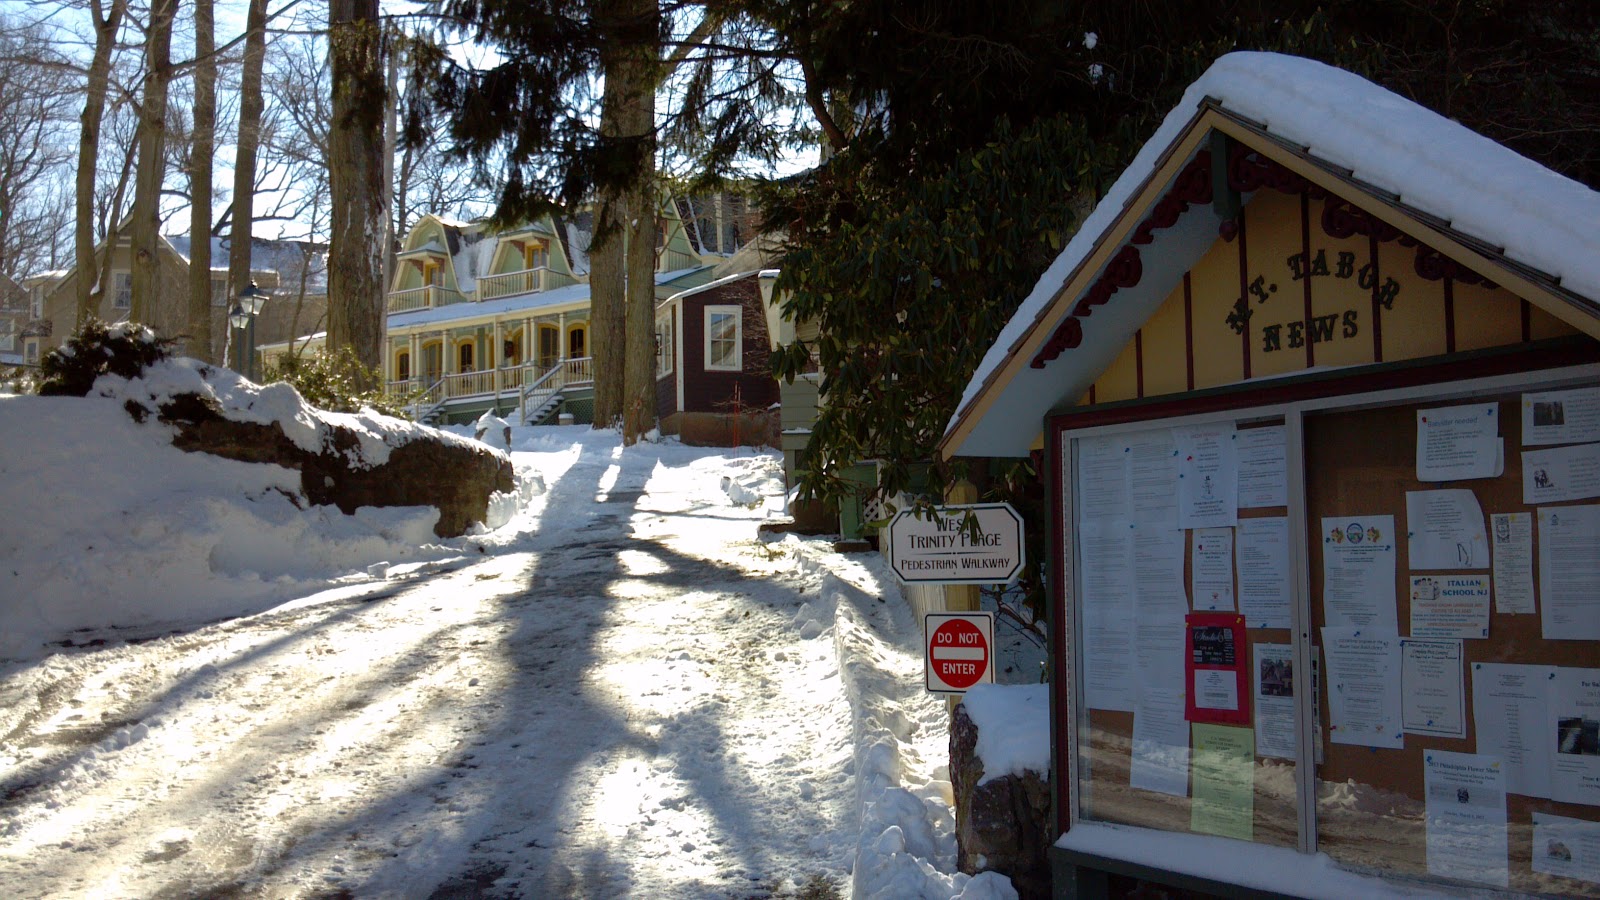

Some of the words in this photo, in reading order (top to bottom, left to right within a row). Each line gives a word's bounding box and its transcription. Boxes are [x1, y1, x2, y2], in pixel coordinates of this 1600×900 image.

[1225, 275, 1278, 335] MT.
[1287, 249, 1400, 310] TABOR
[1263, 310, 1358, 352] NEWS
[908, 534, 956, 549] TRINITY
[901, 559, 958, 571] PEDESTRIAN
[961, 557, 1011, 570] WALKWAY
[937, 632, 953, 644] DO
[959, 632, 979, 644] NOT
[942, 663, 976, 675] ENTER
